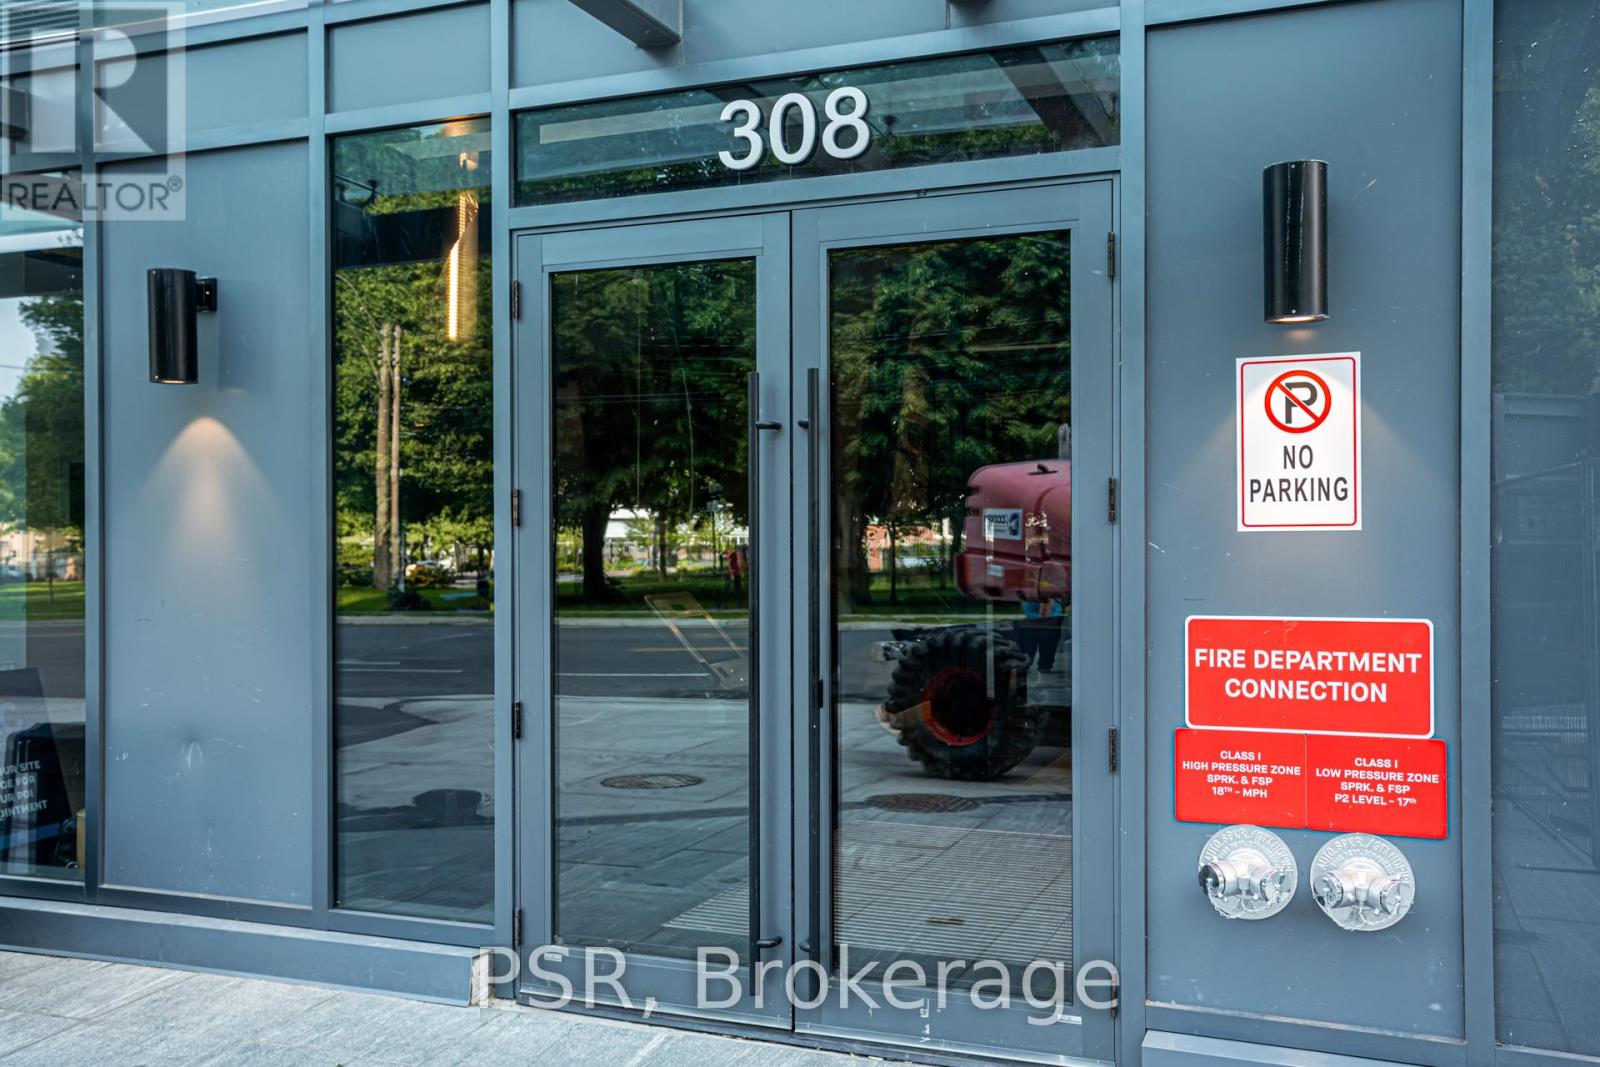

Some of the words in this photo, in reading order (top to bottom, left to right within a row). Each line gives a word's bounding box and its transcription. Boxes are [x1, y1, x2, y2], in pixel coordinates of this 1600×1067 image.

[718, 86, 870, 170] 308
[1283, 444, 1314, 469] NO
[1250, 476, 1348, 502] PARKING
[1194, 647, 1246, 669] FIRE
[1253, 650, 1423, 674] DEPARTMENT
[1224, 678, 1387, 703] CONNECTION
[1219, 750, 1255, 761] CLASS
[20, 760, 41, 772] SITE
[1182, 761, 1209, 771] HIGH
[1211, 762, 1268, 774] PRESSURE
[1270, 765, 1301, 776] ZONE
[1354, 757, 1392, 768] CLASS
[16, 775, 36, 786] FOR
[1207, 774, 1239, 785] SPRK.
[1240, 776, 1249, 785] &
[1251, 776, 1273, 786] FSP
[1315, 768, 1341, 778] LOW
[1344, 769, 1404, 782] PRESSURE
[1406, 773, 1439, 784] ZONE
[1242, 787, 1268, 798] MPH
[1340, 781, 1374, 792] SPRK.
[1376, 783, 1385, 792] &
[1388, 784, 1411, 794] FSP
[1334, 793, 1349, 803] P2
[1352, 795, 1387, 806] LEVEL
